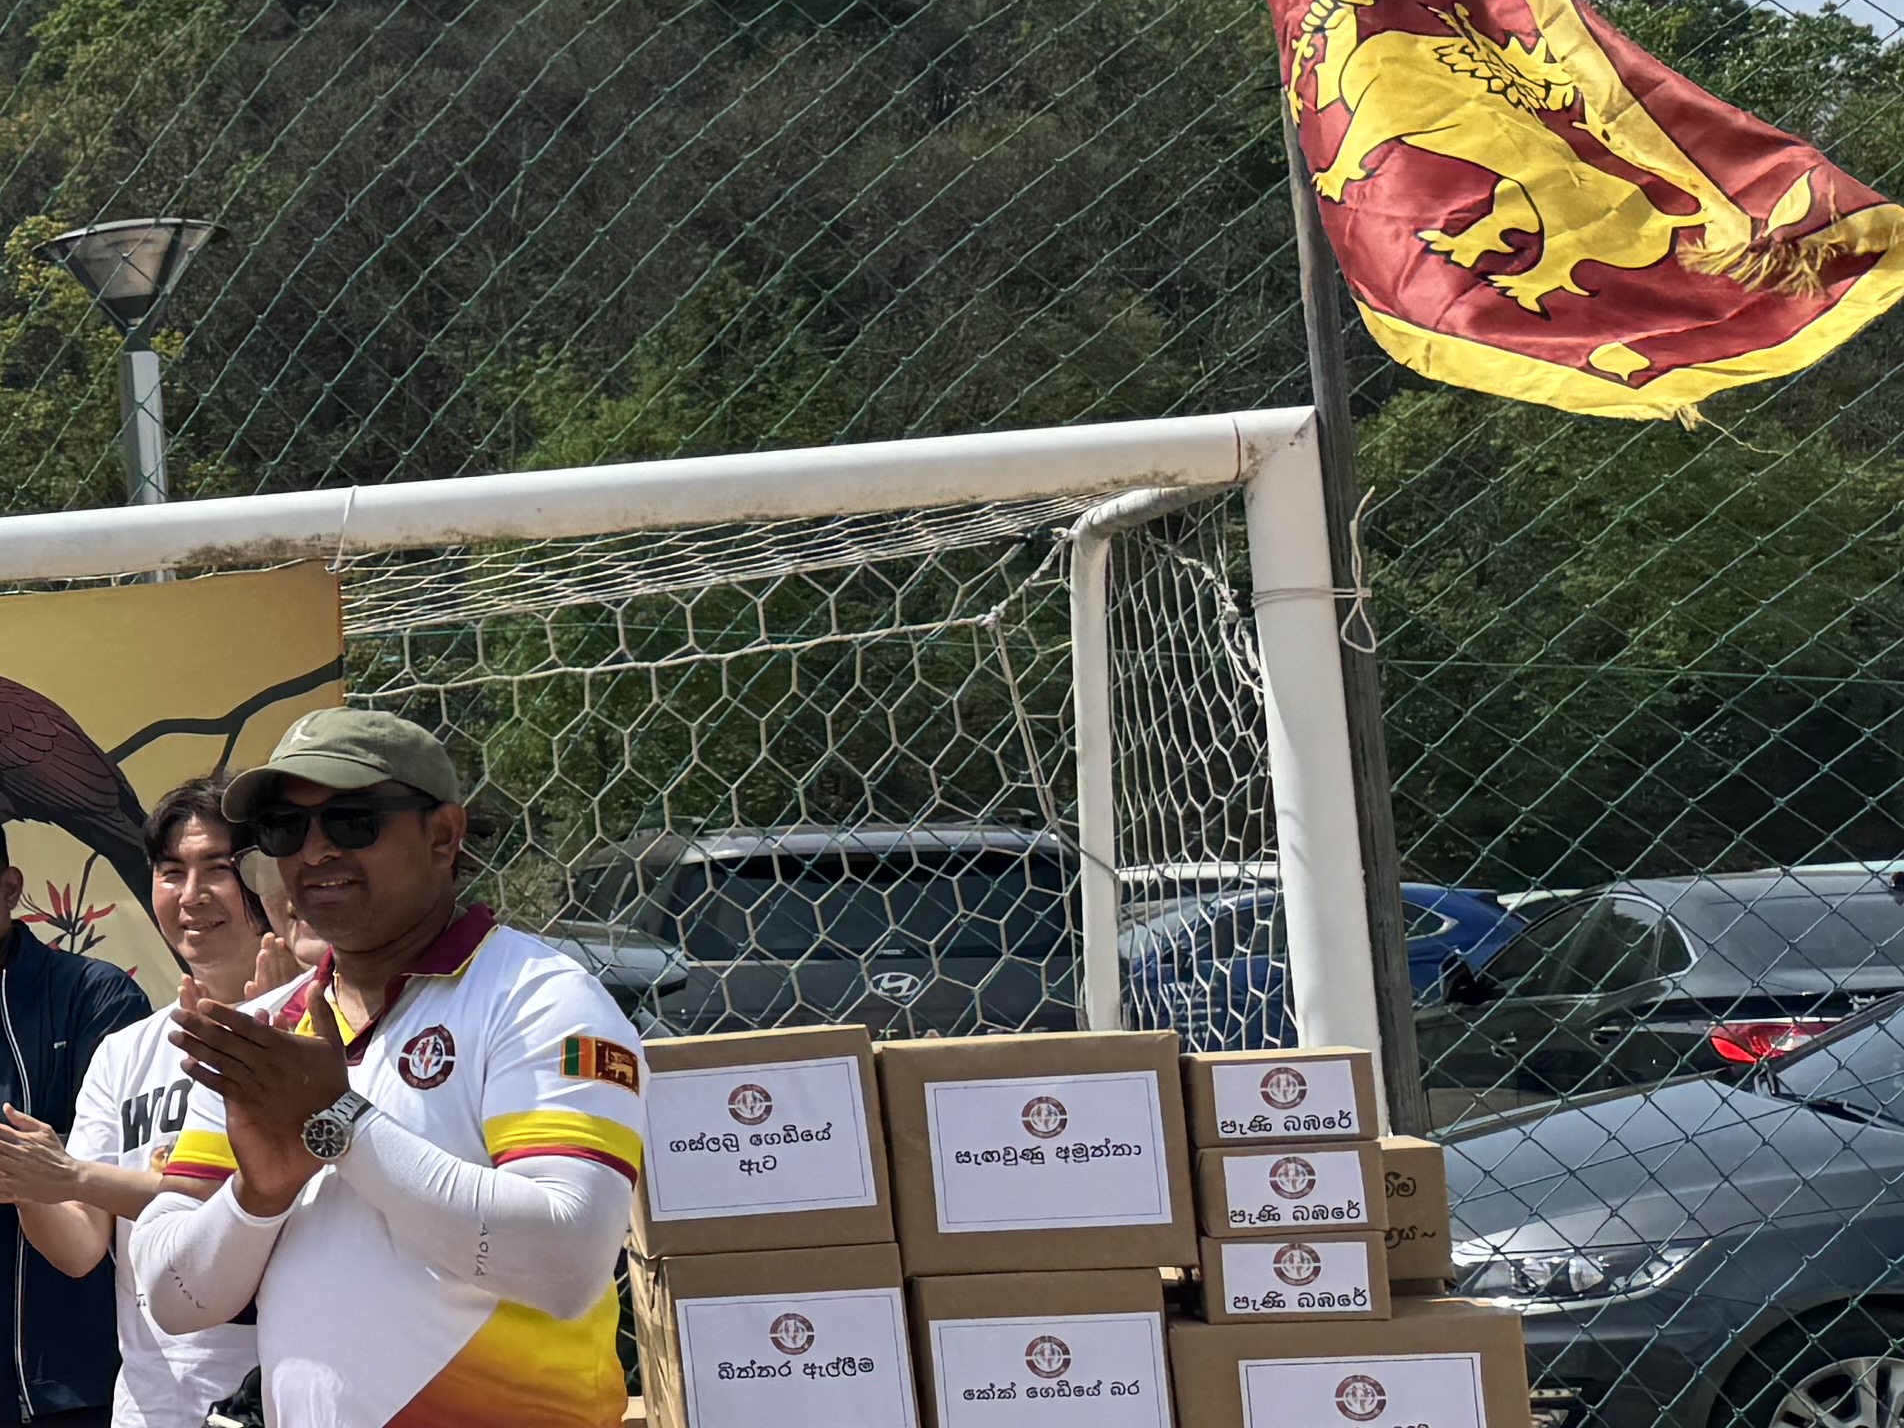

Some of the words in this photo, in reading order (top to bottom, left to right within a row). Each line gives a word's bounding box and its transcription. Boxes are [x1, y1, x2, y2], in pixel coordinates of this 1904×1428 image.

[120, 1077, 192, 1154] WO
[1217, 1114, 1273, 1137] පැණි
[748, 1122, 833, 1147] ගෙඩියේ
[1052, 1135, 1142, 1164] අමුත්තා
[739, 1154, 778, 1177] ඇට
[1227, 1204, 1281, 1226] පැණි
[1232, 1290, 1286, 1312] පැණි
[717, 1359, 792, 1380] බිත්තර
[802, 1356, 875, 1380] ඇල්ලීම
[962, 1381, 1017, 1401] කේක්
[1025, 1379, 1103, 1399] ගෙඩියේ
[1110, 1379, 1140, 1396] බර
